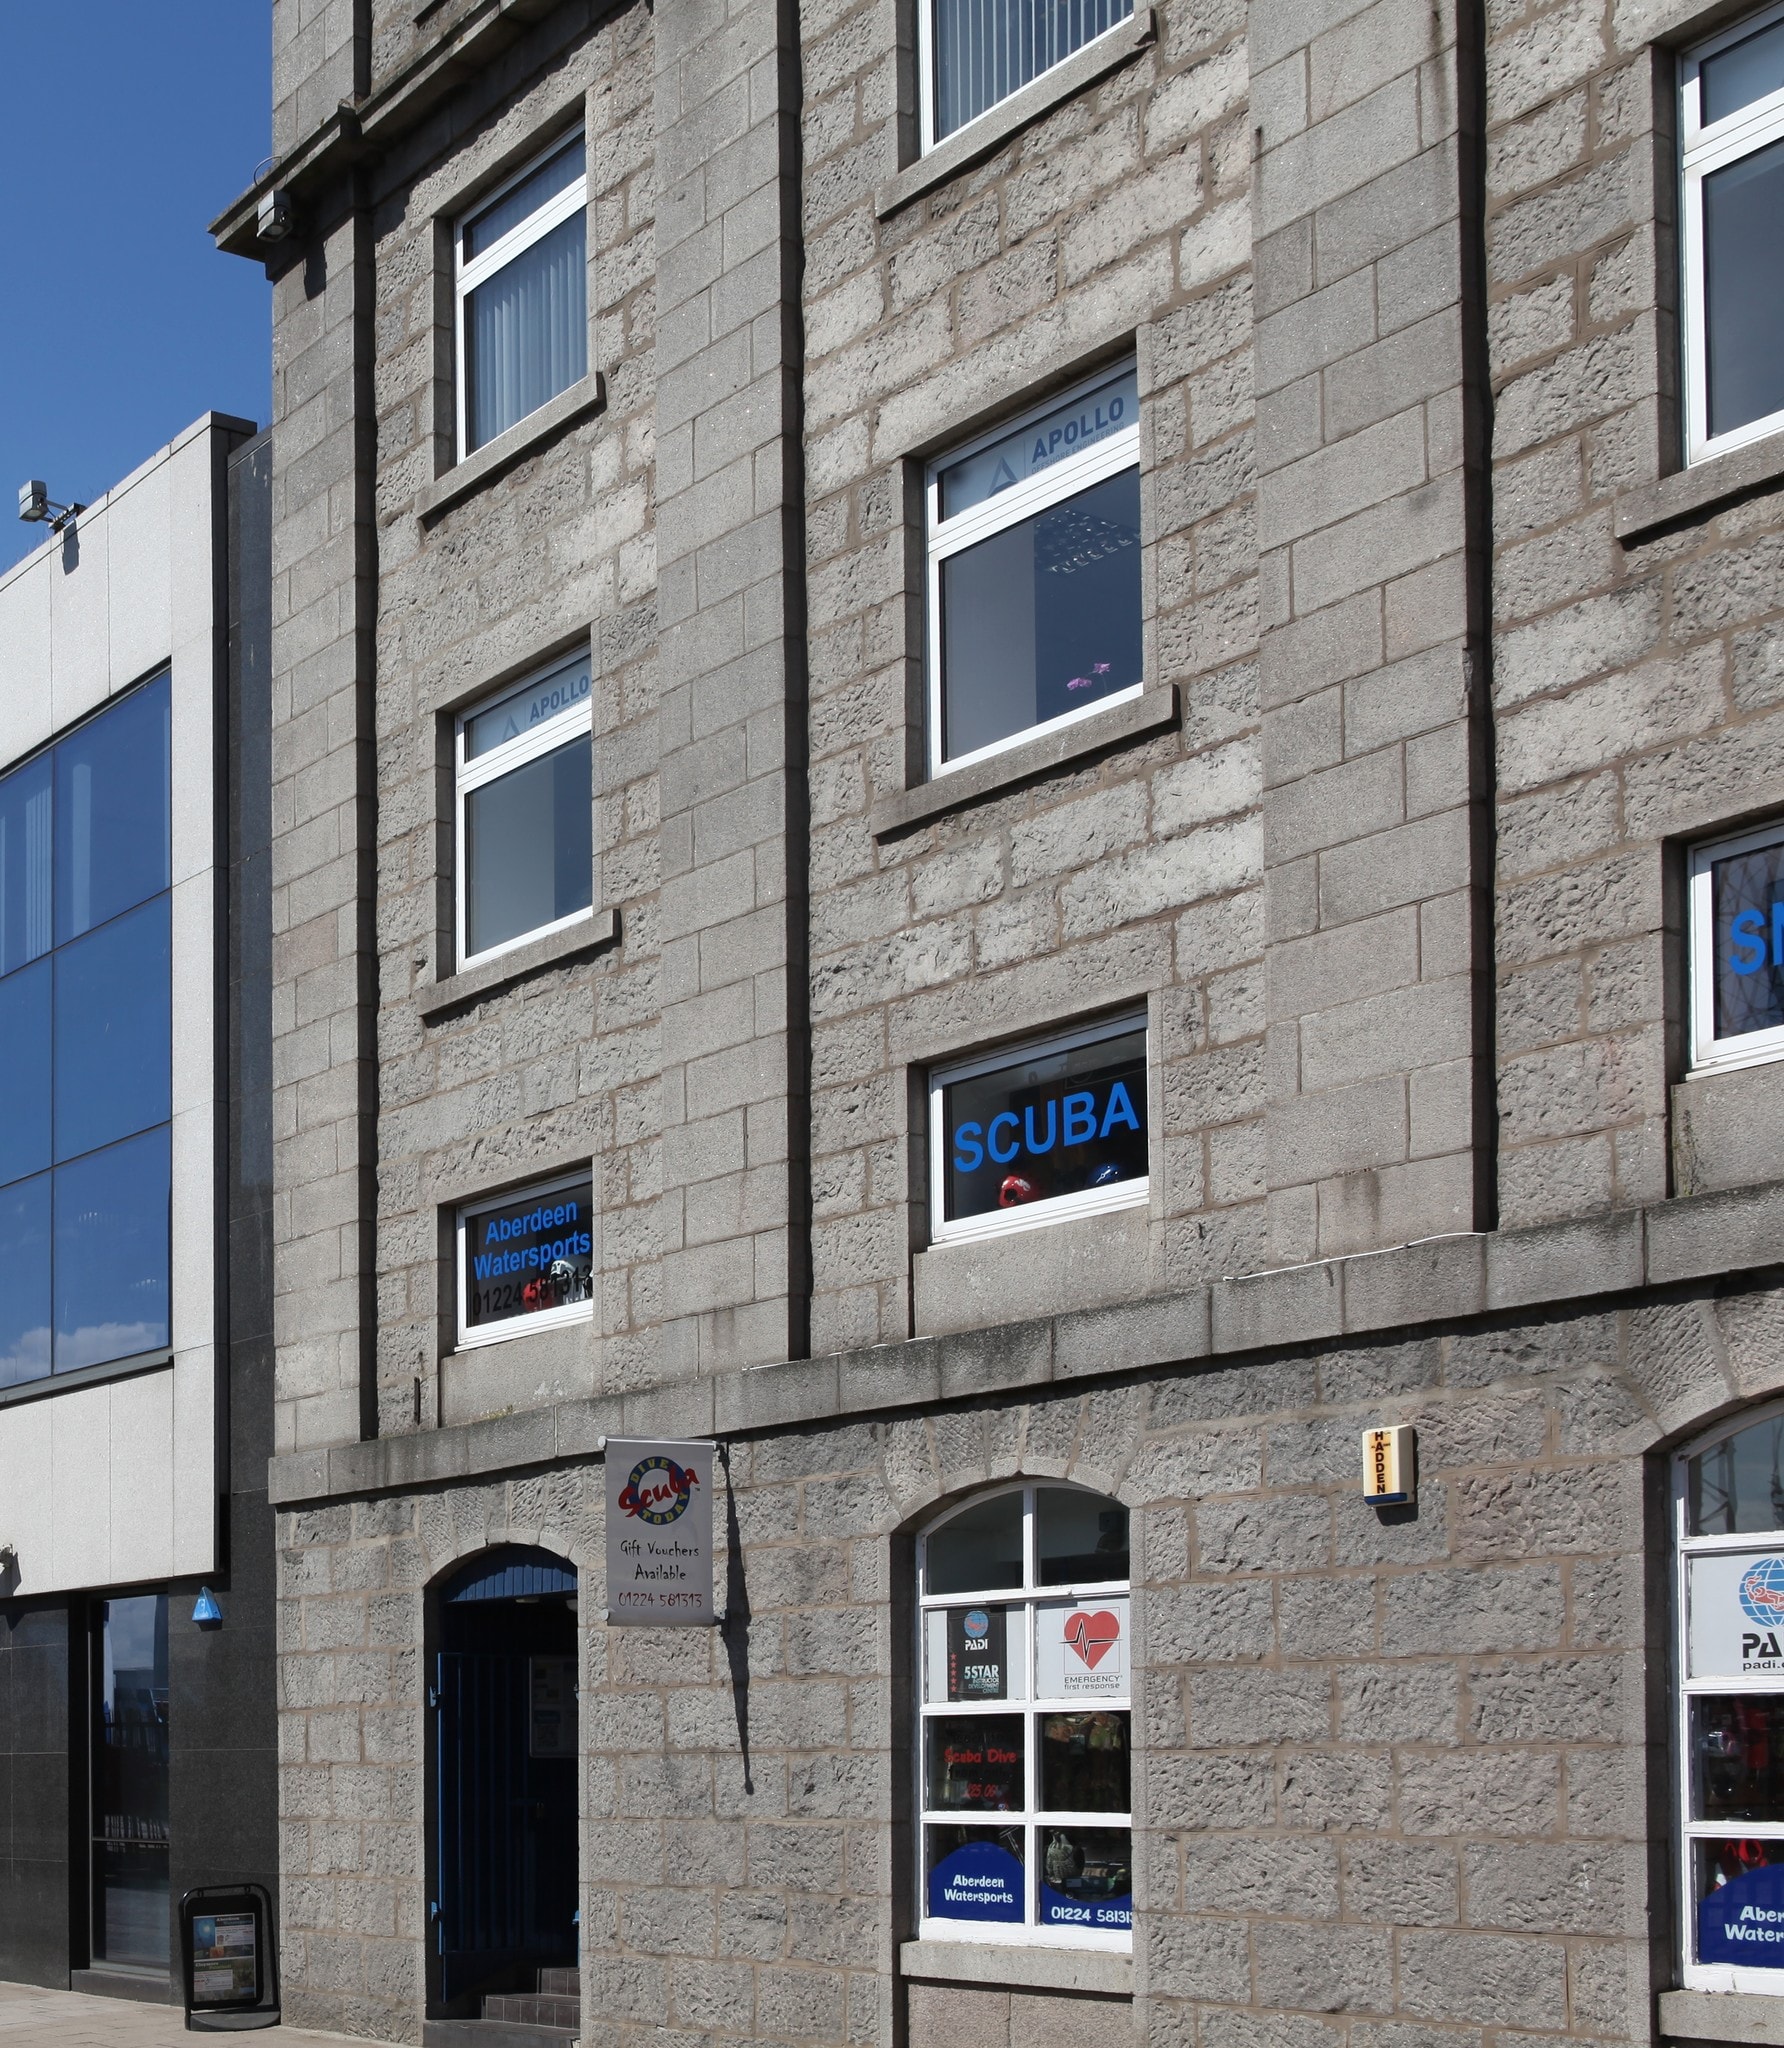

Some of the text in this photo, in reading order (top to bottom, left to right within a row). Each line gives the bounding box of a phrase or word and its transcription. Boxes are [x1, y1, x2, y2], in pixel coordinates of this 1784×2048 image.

[1032, 397, 1124, 464] APOLLO
[1032, 422, 1125, 475] OFFSHORE ENGINEERING
[529, 675, 589, 722] APOLLO
[953, 1081, 1140, 1173] SCUBA
[485, 1201, 577, 1245] Aberdeen
[474, 1230, 591, 1281] Watersports
[473, 1281, 523, 1316] 01224
[630, 1458, 670, 1483] DIVE
[1375, 1430, 1386, 1494] HADDEN
[618, 1465, 700, 1517] Scuba
[642, 1492, 688, 1524] TODAY
[620, 1540, 700, 1558] Gift Vouchers
[634, 1563, 686, 1581] Available
[618, 1592, 703, 1608] 01224 581313
[964, 1638, 989, 1651] PADI
[1064, 1675, 1121, 1684] EMERGENCY
[944, 1748, 1018, 1764] Scuba Dive
[952, 1874, 1005, 1889] Aberdeen
[944, 1888, 1014, 1904] Watersports
[1051, 1906, 1133, 1924] 01224 58131
